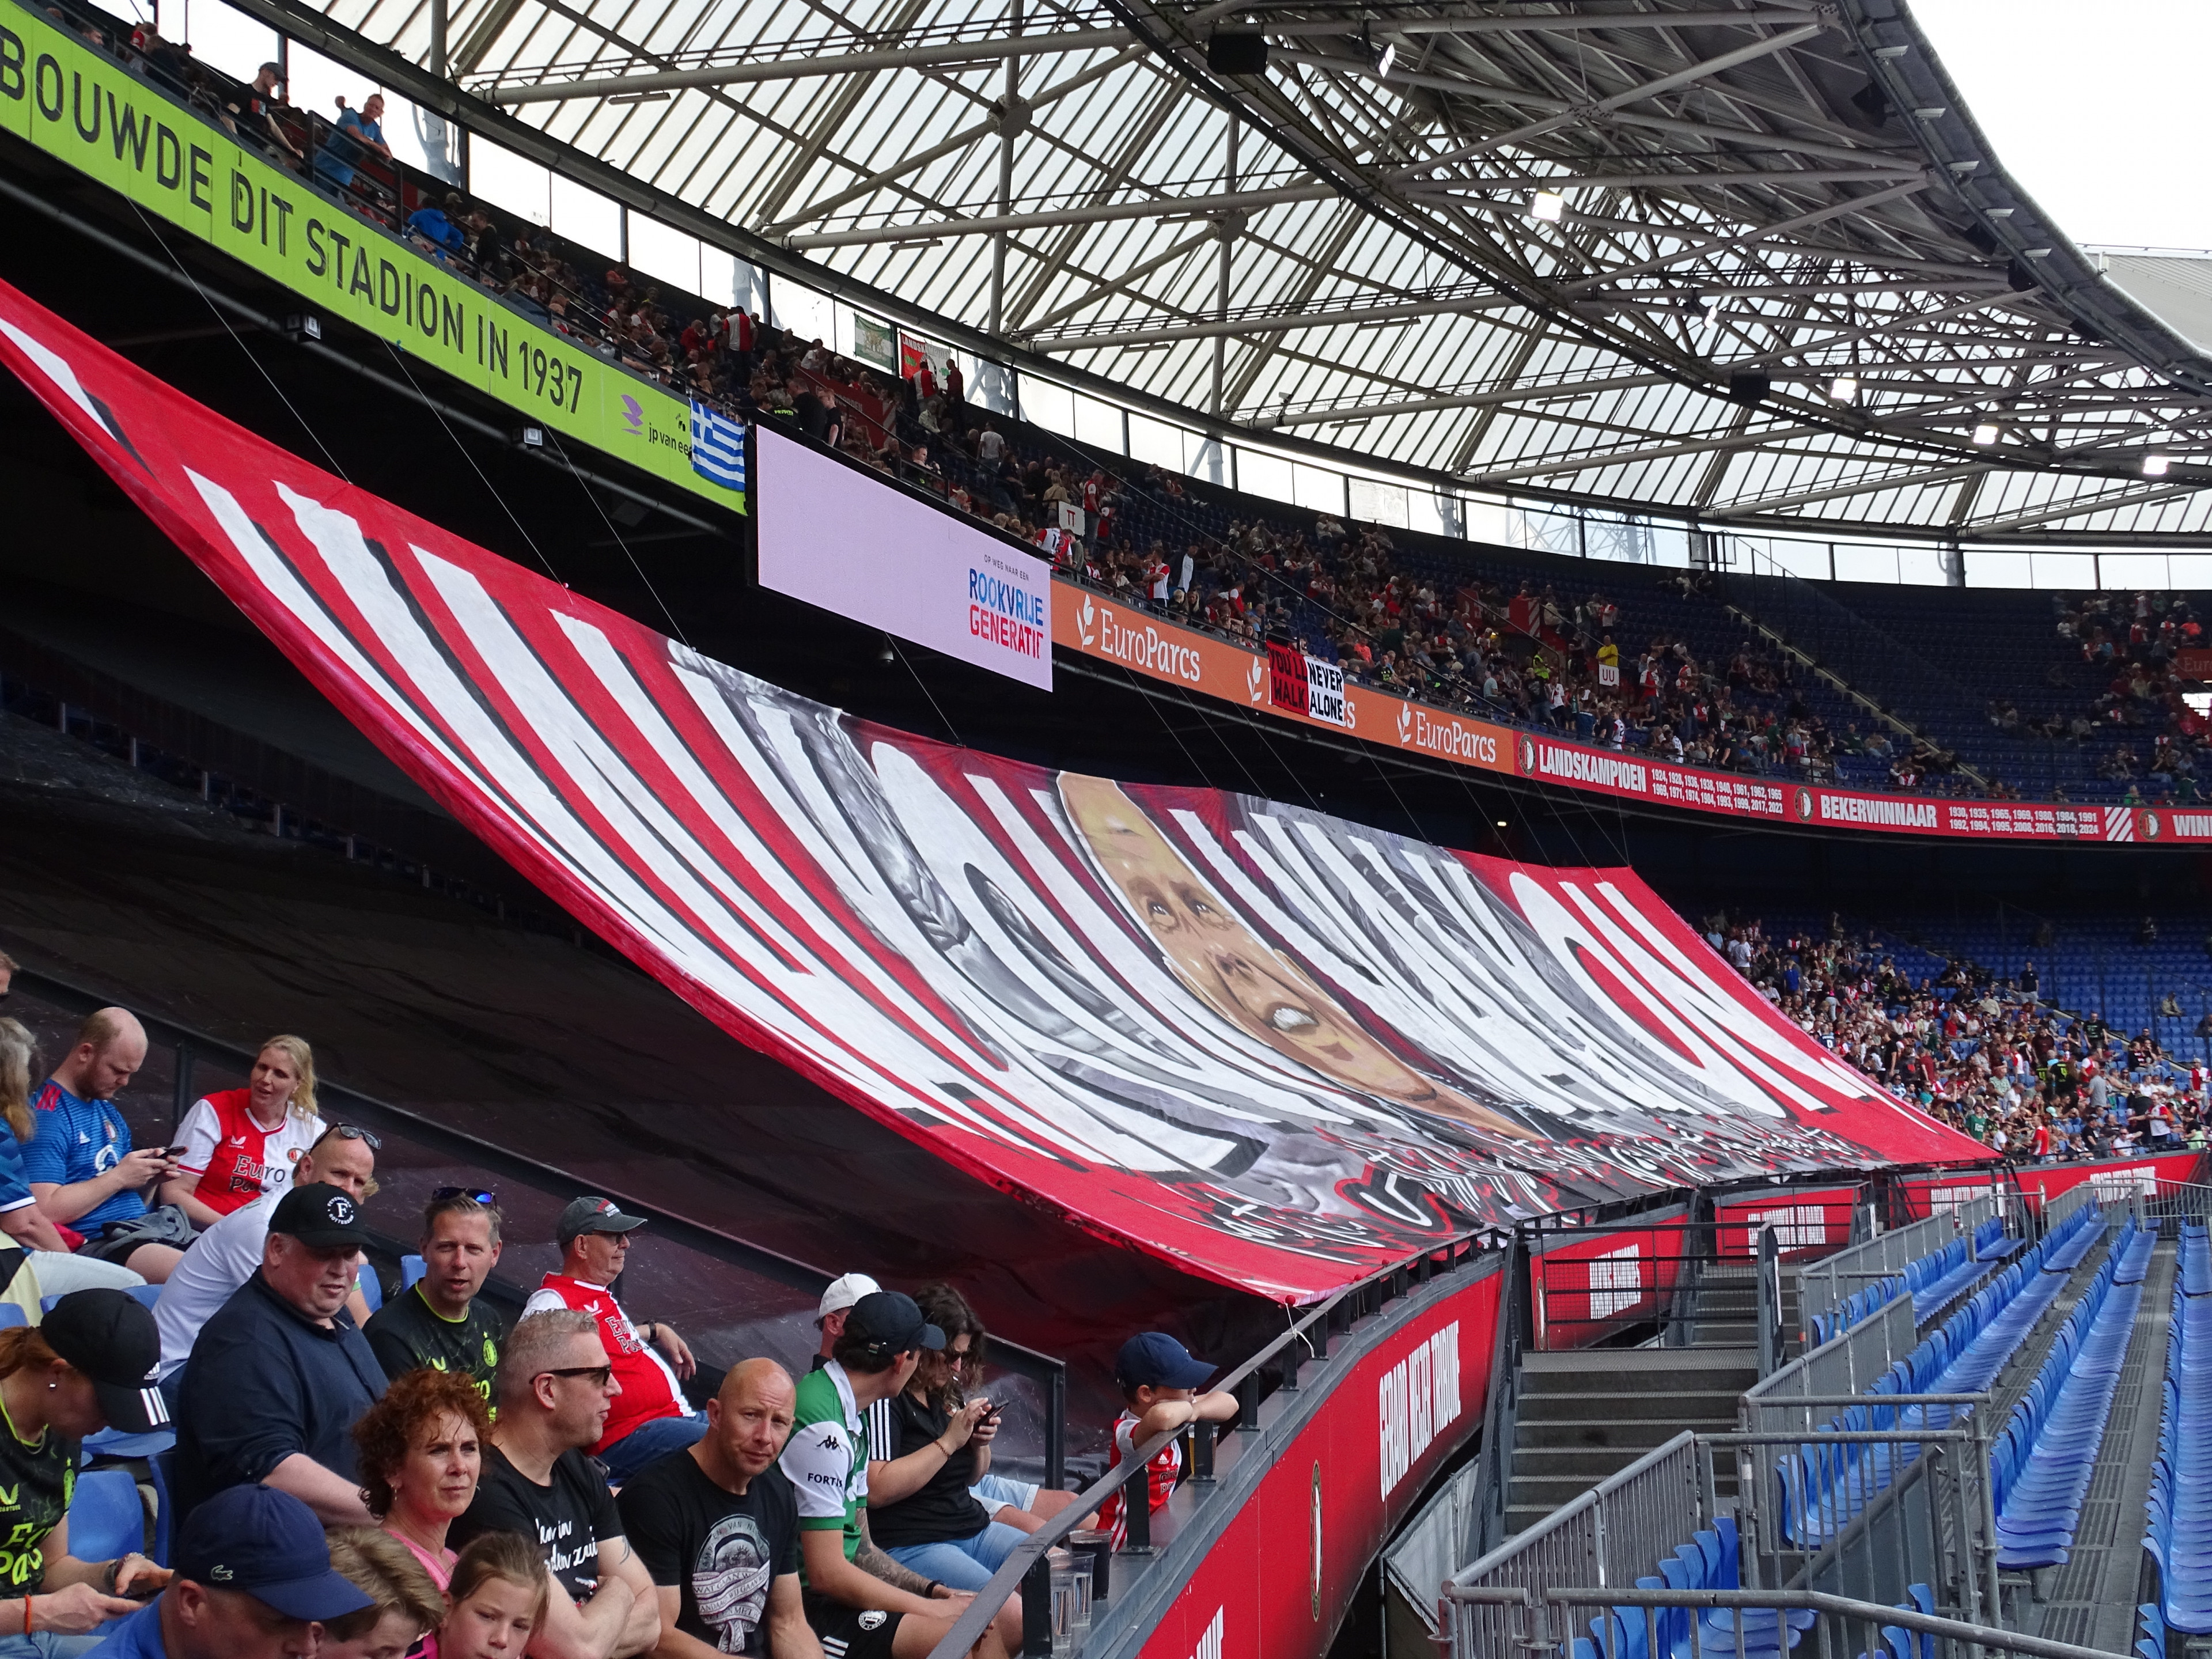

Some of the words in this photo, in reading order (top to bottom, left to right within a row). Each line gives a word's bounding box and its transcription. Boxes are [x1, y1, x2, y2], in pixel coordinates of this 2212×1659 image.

[0, 28, 213, 214] BOUWDE
[232, 167, 294, 257] DIT
[306, 218, 463, 355] STADION
[478, 313, 508, 380] IN
[519, 340, 582, 415] 1937
[649, 422, 658, 444] jp
[660, 431, 677, 450] van
[678, 441, 692, 457] ee
[984, 554, 991, 563] OP
[992, 558, 1003, 571] WEG
[1005, 563, 1018, 578] NAAR
[1020, 570, 1029, 582] EEN
[969, 567, 1044, 627] ROOKVRIJE
[1100, 608, 1200, 682] EuroParcs
[1307, 661, 1343, 693] NEVER
[1273, 677, 1306, 710] WALK
[1309, 691, 1343, 722] ALONE
[1415, 711, 1497, 763] EuroParcs
[1539, 744, 1647, 793] LANDSKAMPIOEN
[1652, 768, 1668, 784] 1924,
[1668, 771, 1684, 787] 1928,
[1684, 775, 1699, 790] 1936,
[1700, 778, 1715, 793] 1938,
[1715, 781, 1732, 796] 1940,
[1733, 783, 1749, 798] 1961,
[1750, 786, 1767, 801] 1962,
[1767, 787, 1782, 801] 1965
[1652, 783, 1669, 799] 1969,
[1669, 786, 1685, 802] 1971,
[1685, 789, 1700, 805] 1974,
[1700, 792, 1716, 808] 1984,
[1717, 794, 1733, 809] 1993,
[1733, 797, 1751, 812] 1999,
[1751, 800, 1768, 814] 2017,
[1768, 801, 1783, 814] 2023
[1820, 794, 1938, 828] BEKERWINNAAR
[1949, 806, 1968, 819] 1930,
[1969, 807, 1990, 820] 1935,
[1990, 808, 2012, 821] 1965,
[2013, 809, 2033, 822] 1969,
[2055, 811, 2077, 824] 1984,
[2078, 812, 2097, 823] 1991
[1949, 819, 1969, 832] 1992,
[1969, 820, 1990, 833] 1994,
[1991, 820, 2013, 834] 1995,
[2035, 823, 2056, 835] 2016,
[2056, 823, 2078, 835] 2018,
[2079, 824, 2099, 835] 2024
[232, 1154, 286, 1183] Euro
[328, 1213, 354, 1225] ROTTERDAM
[336, 1202, 349, 1218] F
[1379, 1359, 1409, 1503] GERARD
[1431, 1319, 1461, 1438] TRIBUNE
[807, 1472, 843, 1487] FORTIS
[727, 1521, 742, 1531] VAN
[694, 1583, 715, 1595] WAT
